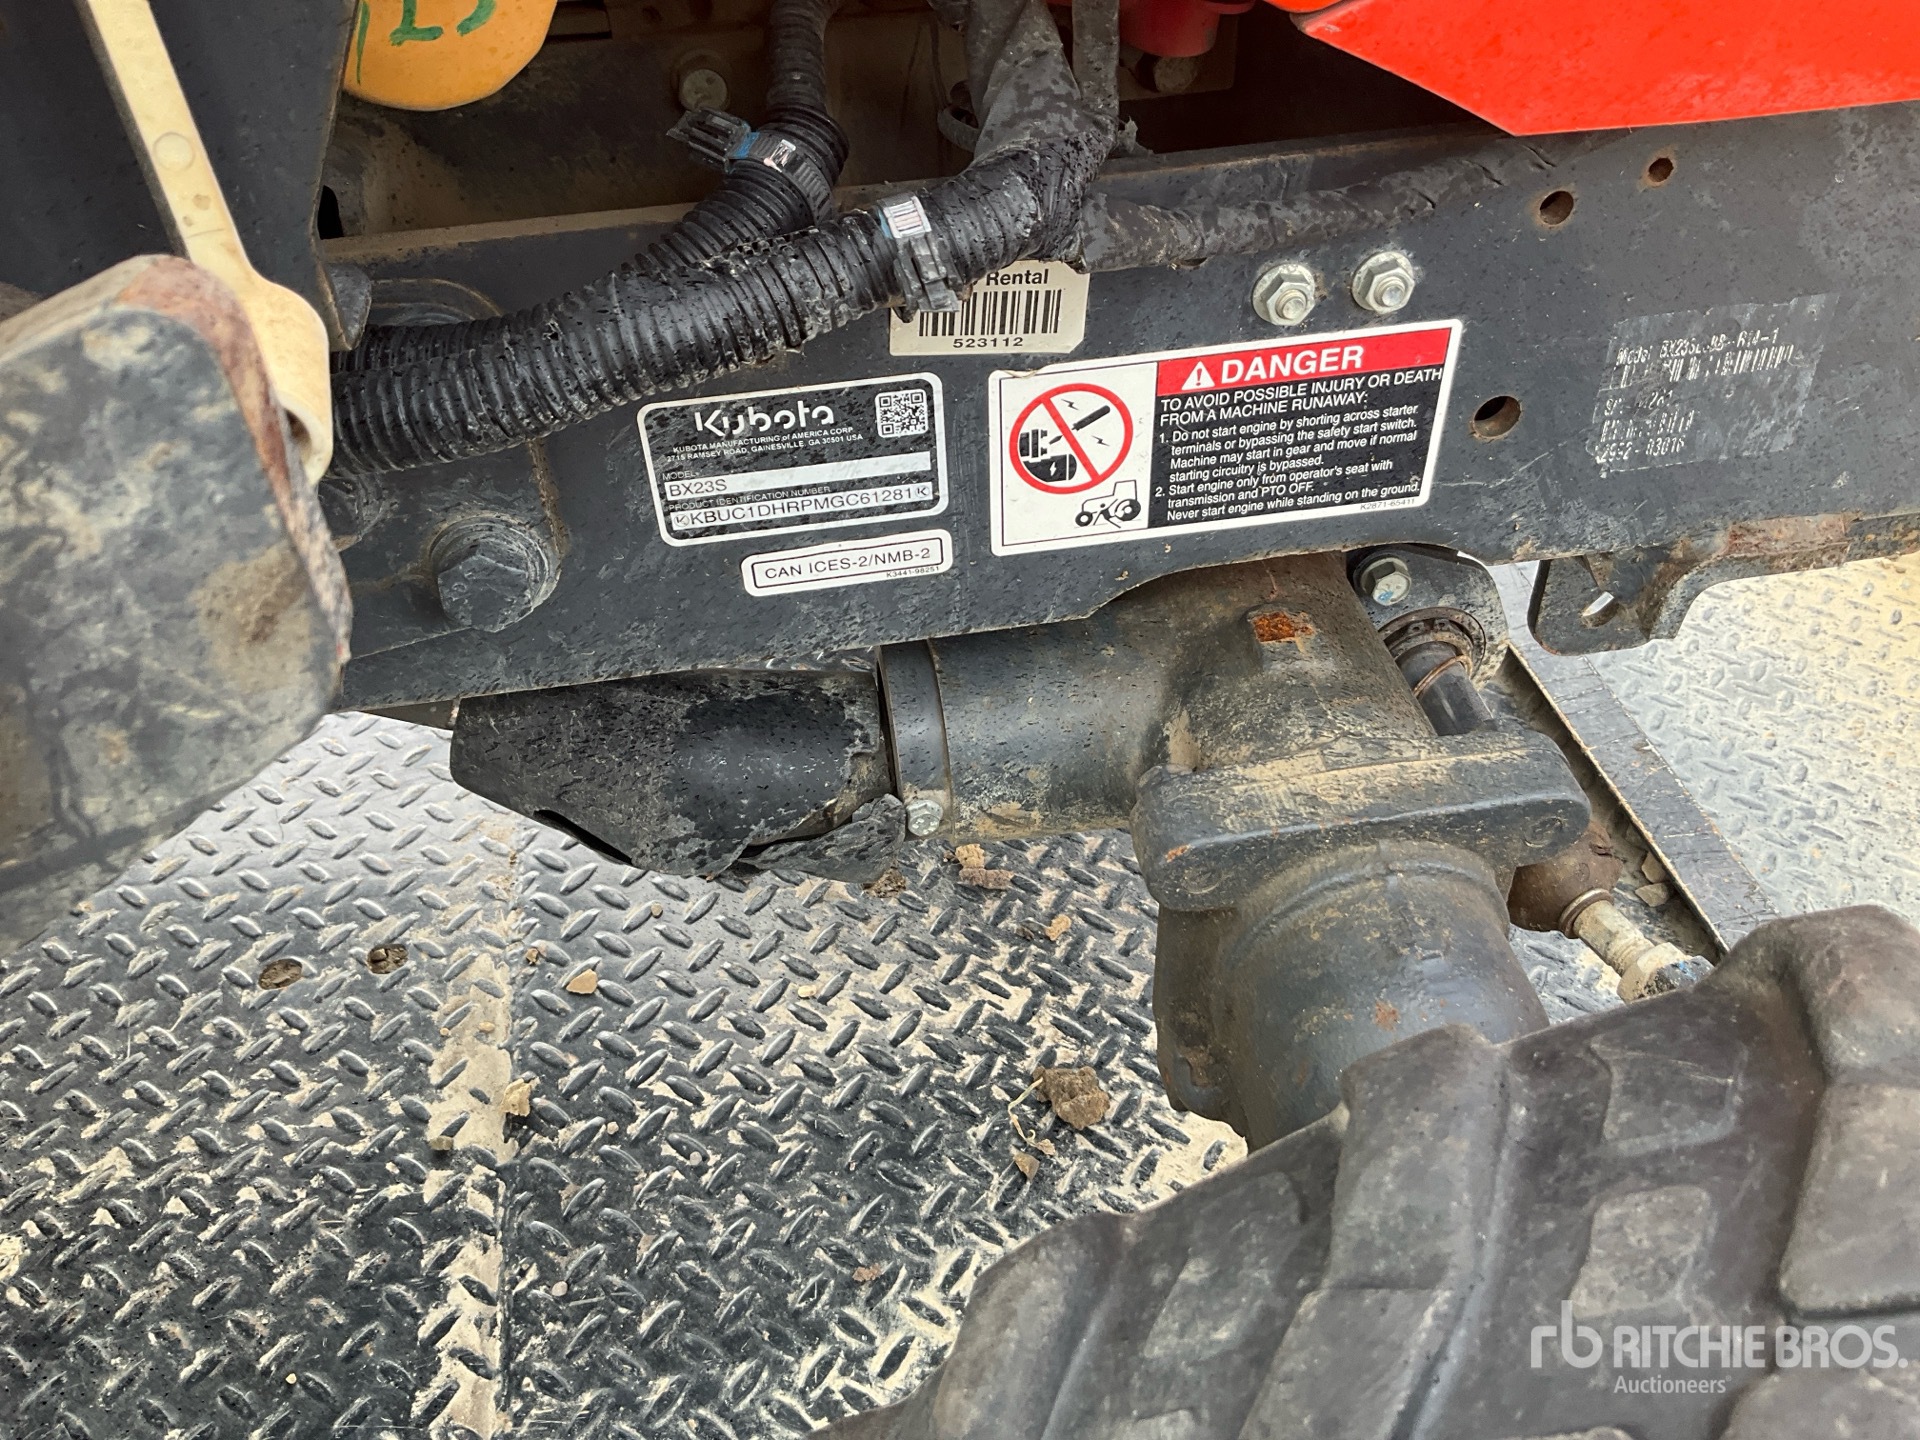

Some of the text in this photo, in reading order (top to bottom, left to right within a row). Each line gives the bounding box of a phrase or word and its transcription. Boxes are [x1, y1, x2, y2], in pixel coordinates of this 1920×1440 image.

[986, 268, 1049, 286] Rental
[953, 336, 1024, 348] 523112
[1221, 345, 1364, 384] DANGER
[1161, 368, 1443, 412] TO AVOID POSSIBLE INJURY OR DEATH
[694, 400, 834, 437] Kubota
[1160, 391, 1368, 427] FROM A MACHINE RUNAWAY:
[1160, 405, 1419, 444] 1. Do not start engine by shorting across starter
[667, 453, 687, 463] 2715
[687, 450, 722, 460] RAMSEY
[808, 438, 821, 446] GA
[822, 436, 845, 445] 30501
[846, 433, 864, 442] USA
[673, 443, 708, 454] KUBOTA
[709, 434, 780, 450] MANUFACTURING
[781, 434, 791, 442] of
[791, 430, 829, 440] AMERICA
[1170, 430, 1418, 470] Machine may start in gear and move if normal
[1171, 417, 1417, 456] terminals or bypassing the safety start switch.
[662, 470, 697, 481] MODEL
[1155, 459, 1394, 498] 2. Start engine only from operator's seat with
[1169, 454, 1324, 483] starting circuitry is bypassed.
[668, 486, 831, 511] PRODUCT IDENTIFICATION NUMBER
[669, 478, 728, 497] BX23S
[1167, 482, 1420, 521] Never start engine while standing on the ground.
[1168, 481, 1314, 509] transmission and PTO OFF.
[690, 487, 912, 525] KBUC1DHRPMGC61281
[765, 547, 931, 579] CAN ICES-2/NMB-2
